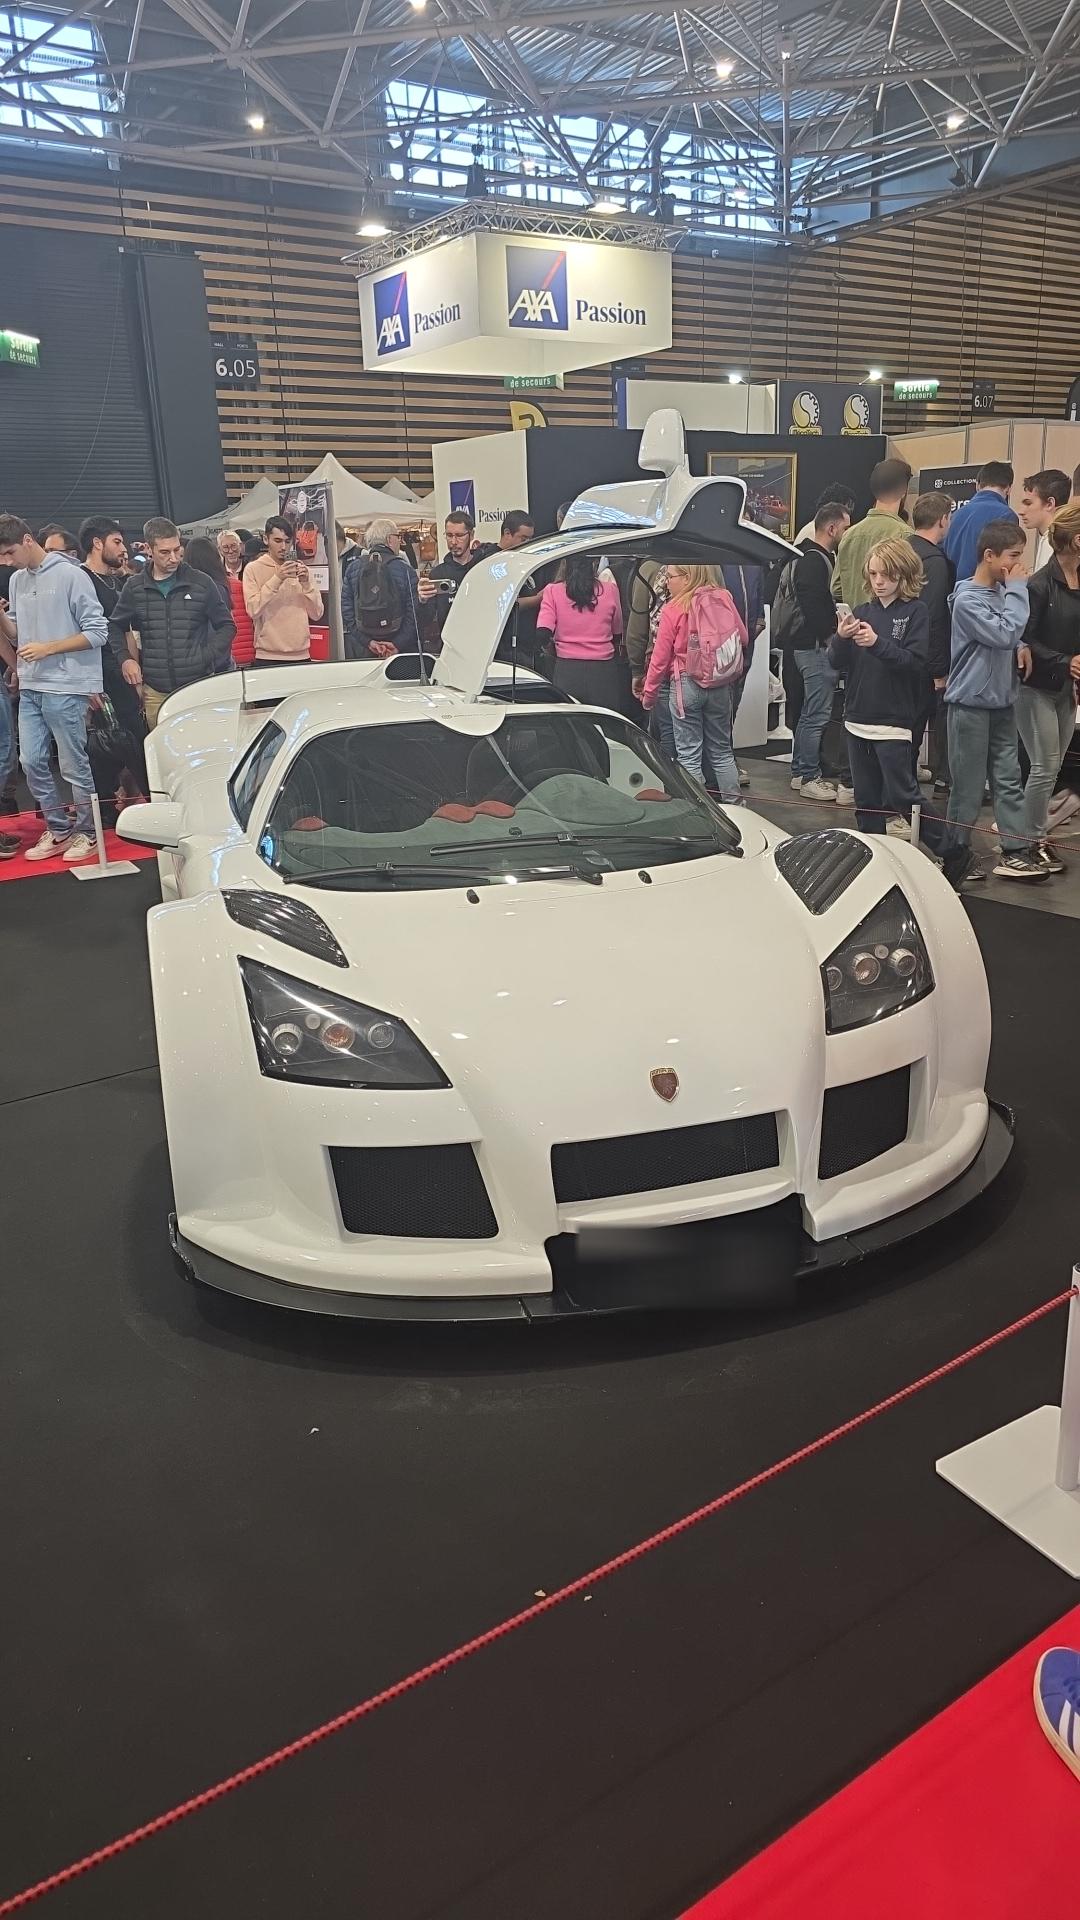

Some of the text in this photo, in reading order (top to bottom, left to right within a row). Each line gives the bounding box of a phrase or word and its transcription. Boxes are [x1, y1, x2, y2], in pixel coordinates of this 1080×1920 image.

[509, 289, 559, 323] AXA
[575, 299, 647, 326] Passion
[413, 302, 461, 333] Passion
[377, 313, 405, 349] AXA
[215, 358, 256, 378] 6.05
[510, 377, 551, 388] de secours
[902, 382, 930, 393] Sortie
[898, 391, 933, 400] de secours
[974, 395, 994, 408] 6.07
